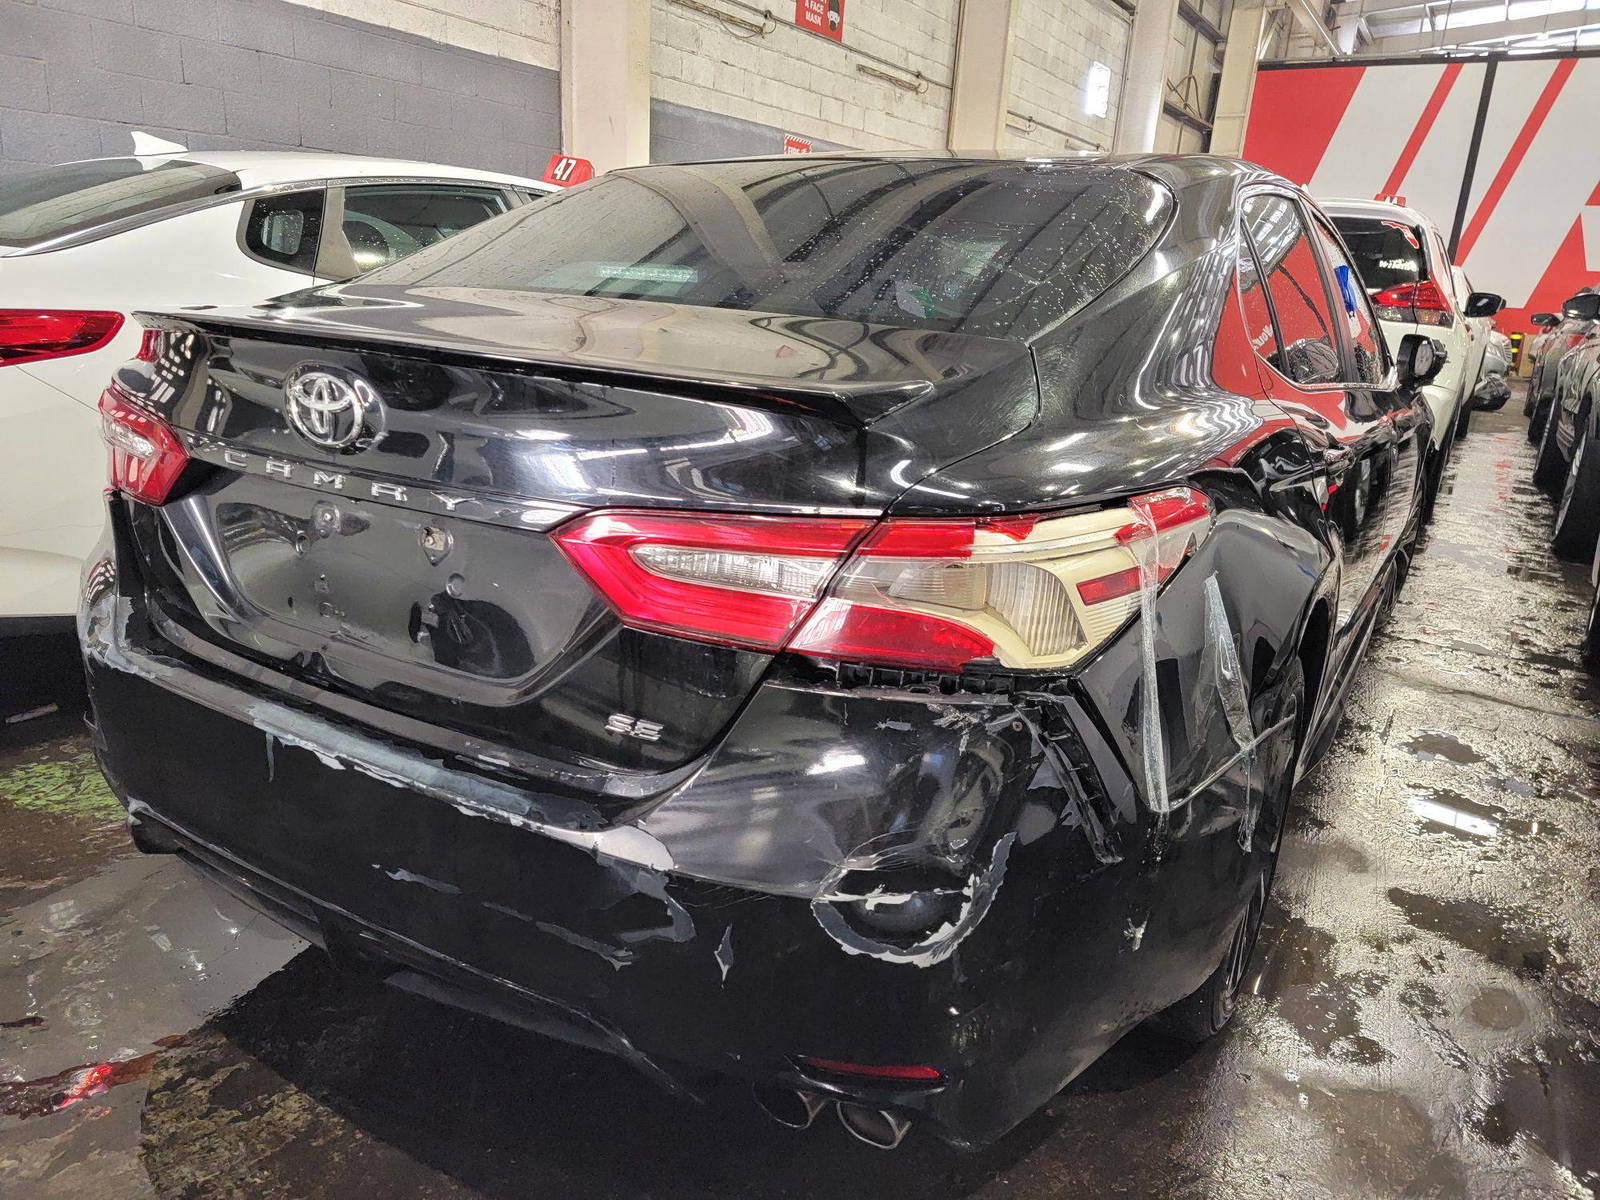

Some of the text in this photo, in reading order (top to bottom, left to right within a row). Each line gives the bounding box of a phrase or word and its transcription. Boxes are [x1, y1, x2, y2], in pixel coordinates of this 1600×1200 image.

[804, 0, 825, 14] A FACE
[805, 10, 822, 26] MASK
[553, 158, 577, 181] 47
[224, 450, 483, 511] CAMRY
[604, 713, 664, 741] SE
